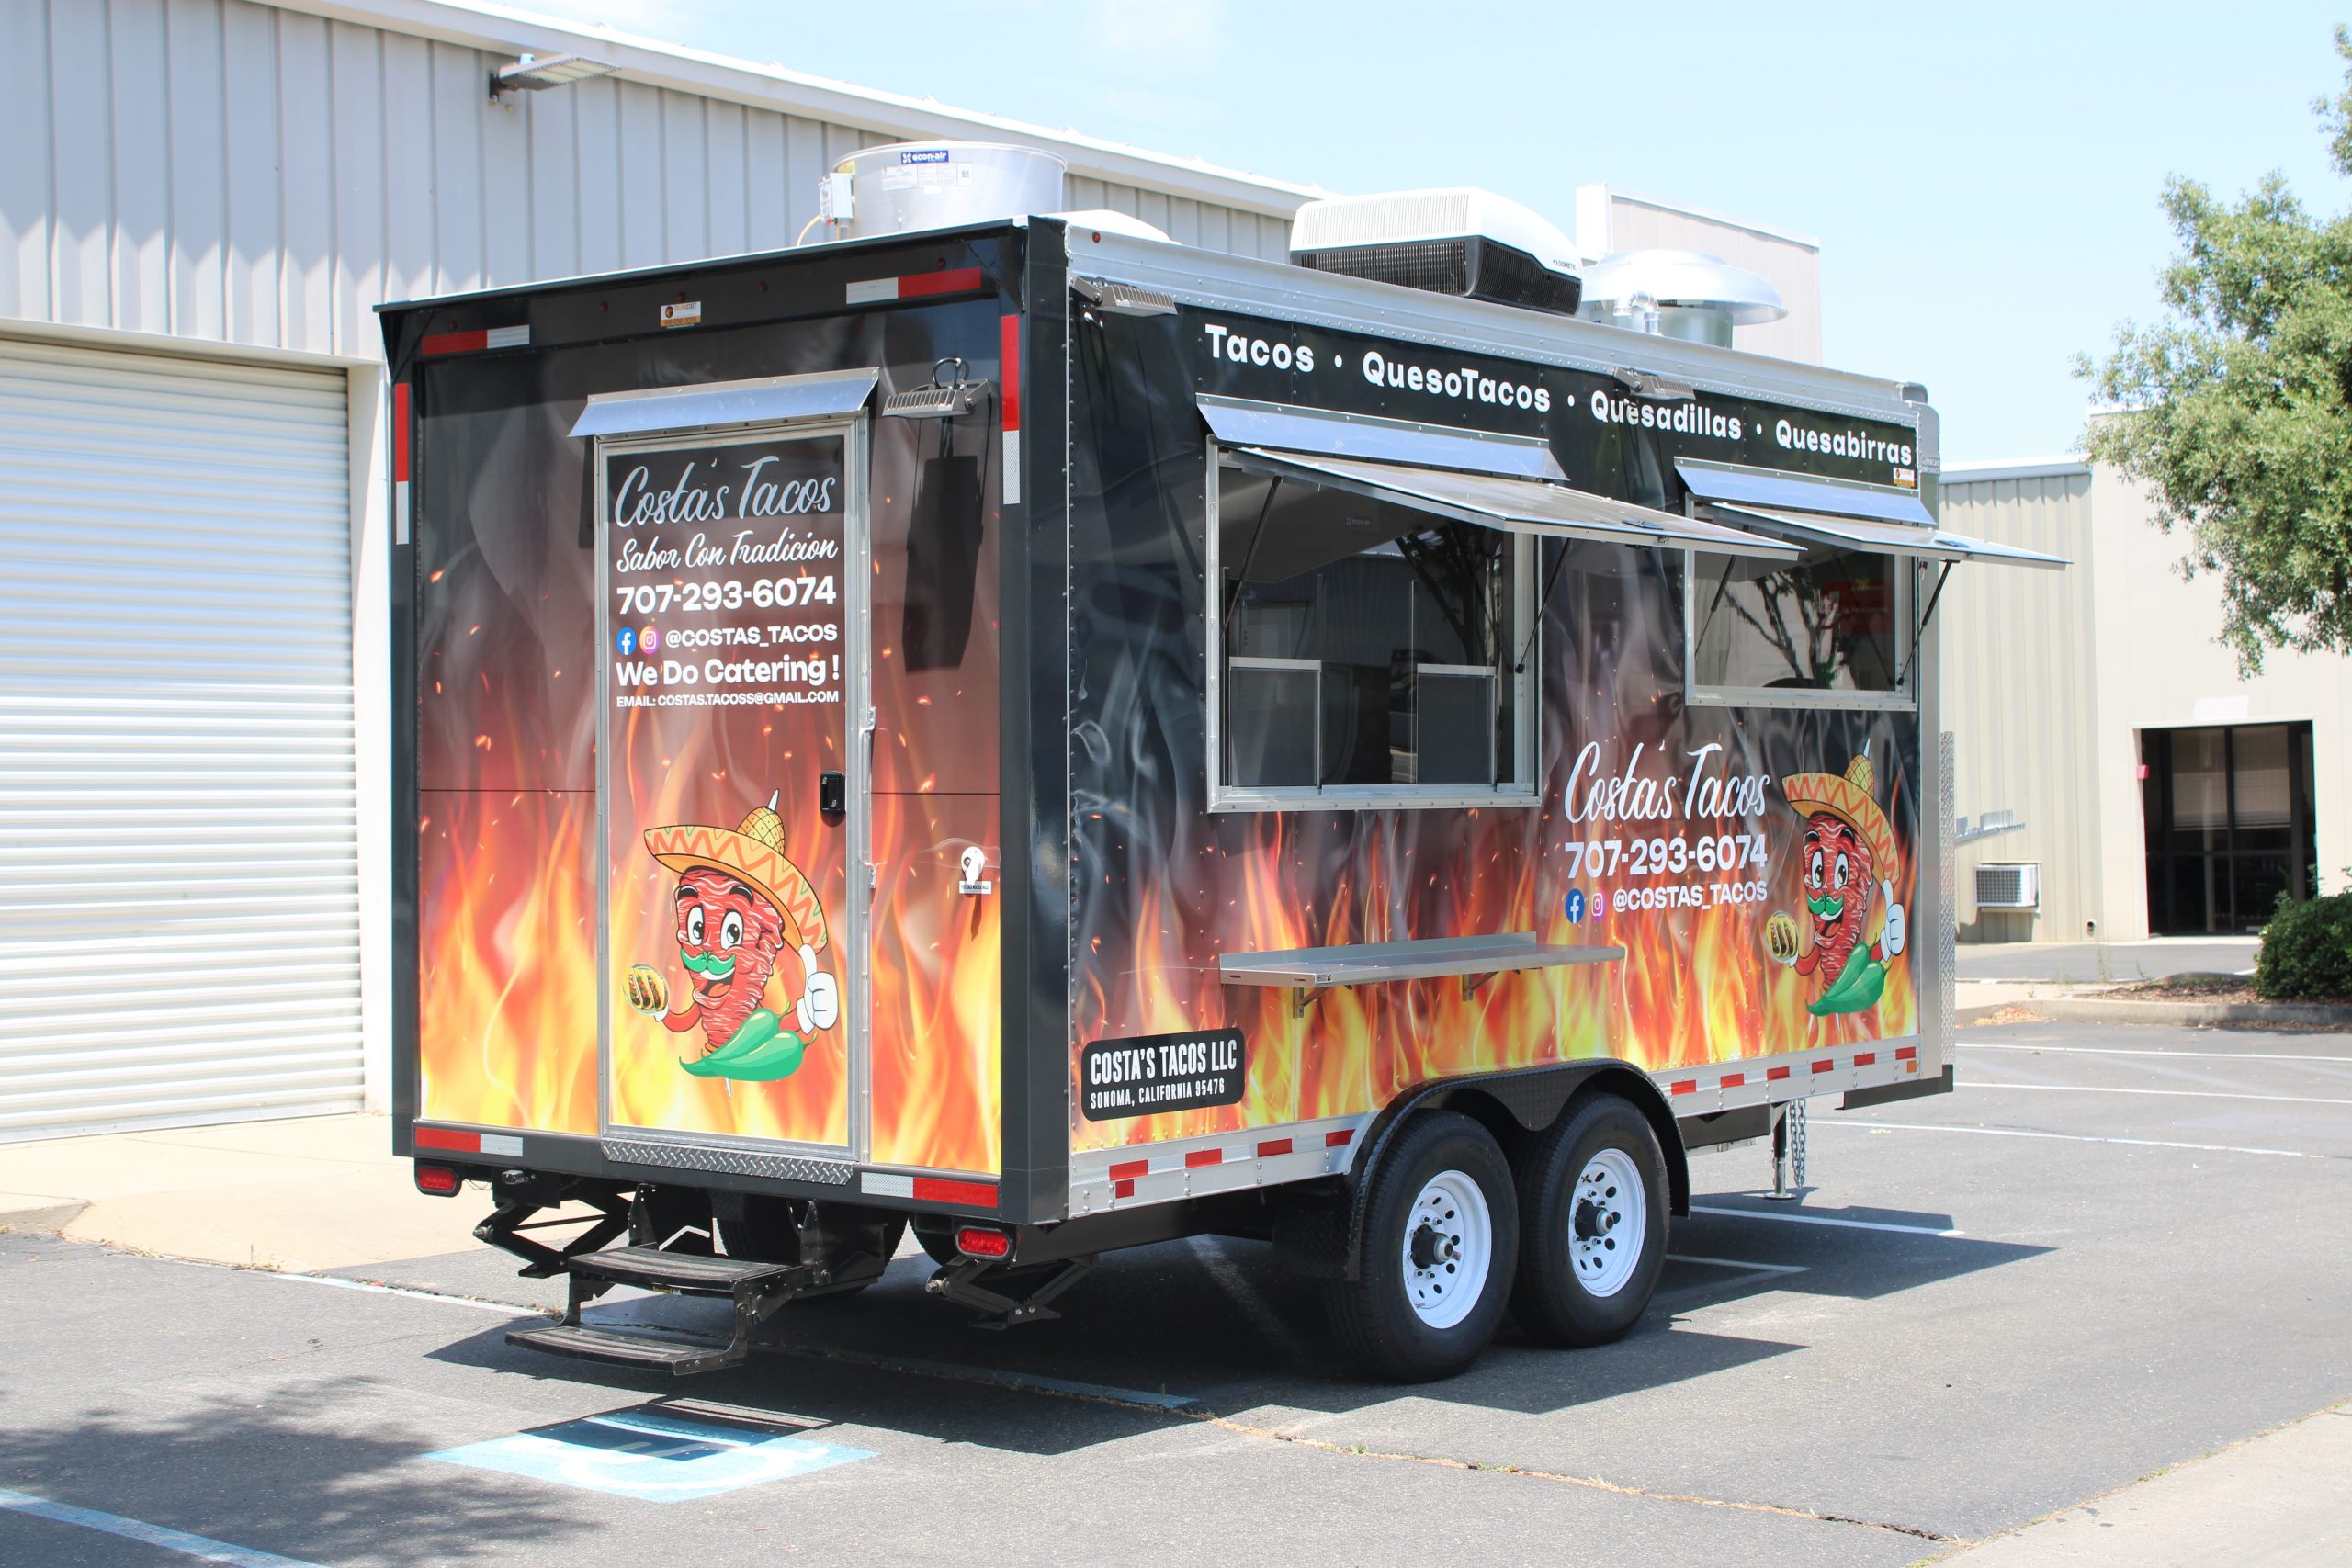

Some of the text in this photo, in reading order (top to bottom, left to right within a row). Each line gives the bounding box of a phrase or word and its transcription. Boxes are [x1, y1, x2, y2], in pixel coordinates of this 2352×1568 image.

[1204, 323, 1913, 467] Tacos QuesoTacos Quesadillas Quesabirras
[614, 455, 836, 528] Costa's Tacos
[616, 526, 838, 573] Sabor Con Tradicion
[616, 575, 837, 615] 707-293-6074
[665, 623, 838, 648] @COSTAS_TACOS
[616, 661, 658, 686] We
[663, 660, 699, 685] Do
[616, 691, 839, 707] EMAIL: COSTAS.TACOSS@GMAIL.COM
[1565, 739, 1771, 824] Costa's Tacos
[1565, 834, 1768, 879] 707-293-6074
[1612, 880, 1768, 913] @COSTAS_TACOS
[1091, 1039, 1238, 1086] COSTA'S TACOS LLC
[1091, 1077, 1225, 1110] SONOMA, CALIFORNIA 95476
